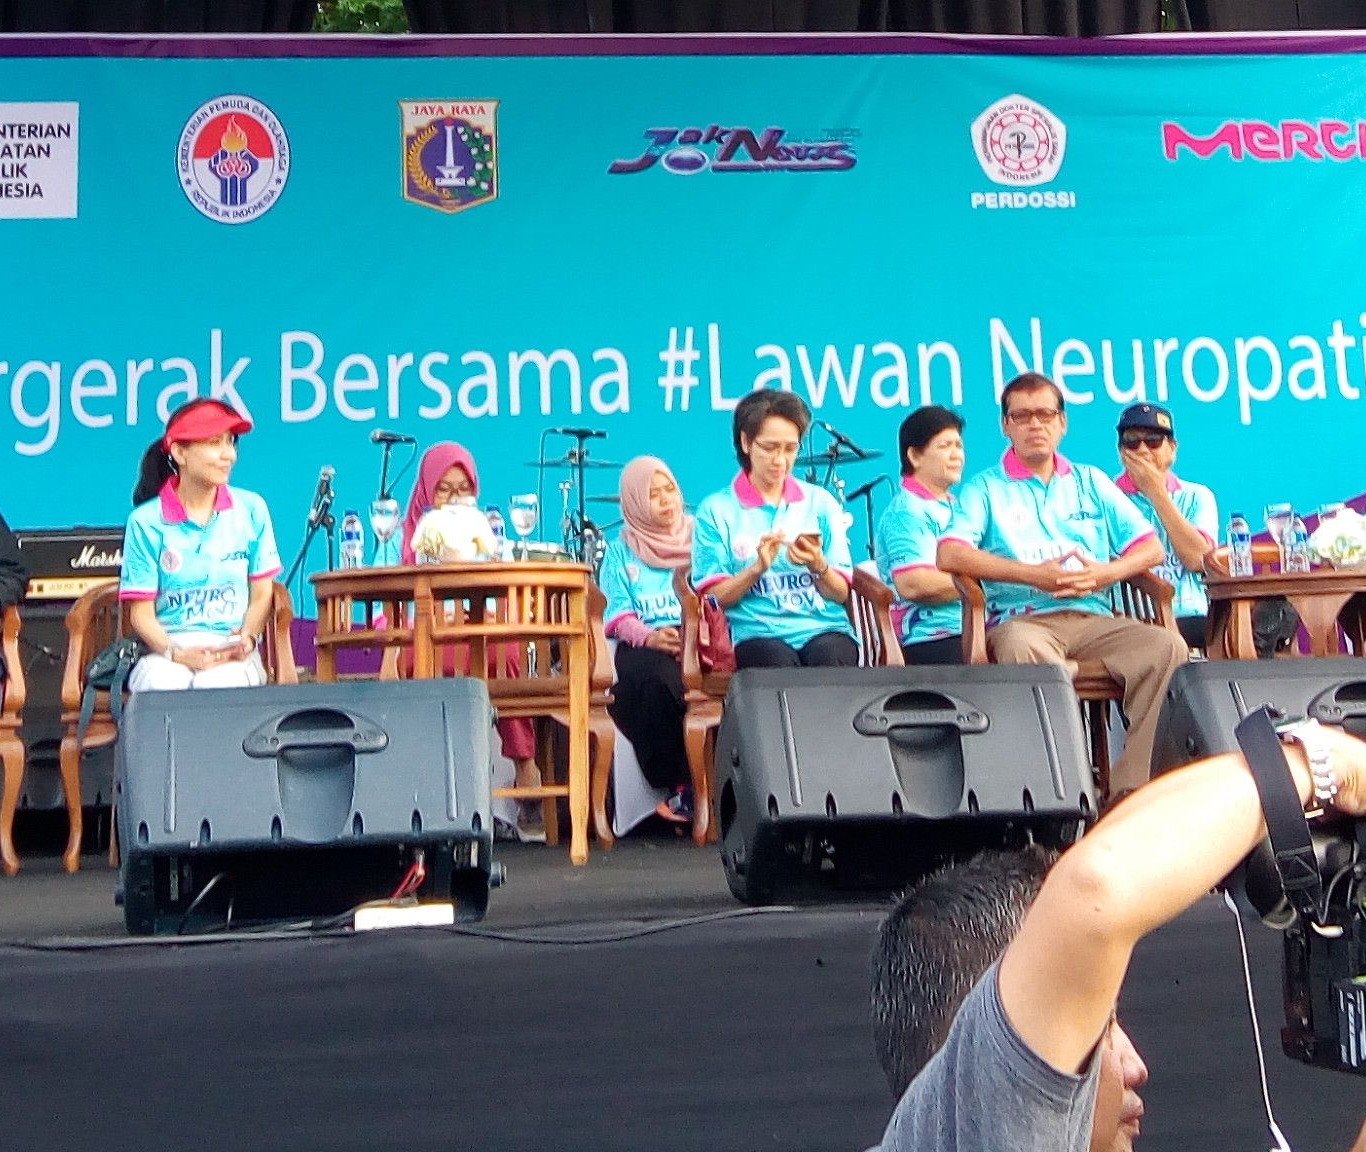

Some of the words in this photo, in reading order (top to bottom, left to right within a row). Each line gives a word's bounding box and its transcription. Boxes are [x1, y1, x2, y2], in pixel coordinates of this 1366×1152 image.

[412, 104, 445, 116] JAYA
[451, 104, 486, 116] RAYA
[970, 191, 1076, 209] PERDOSSI
[279, 330, 631, 425] Bersama
[657, 322, 964, 413] #Lawan
